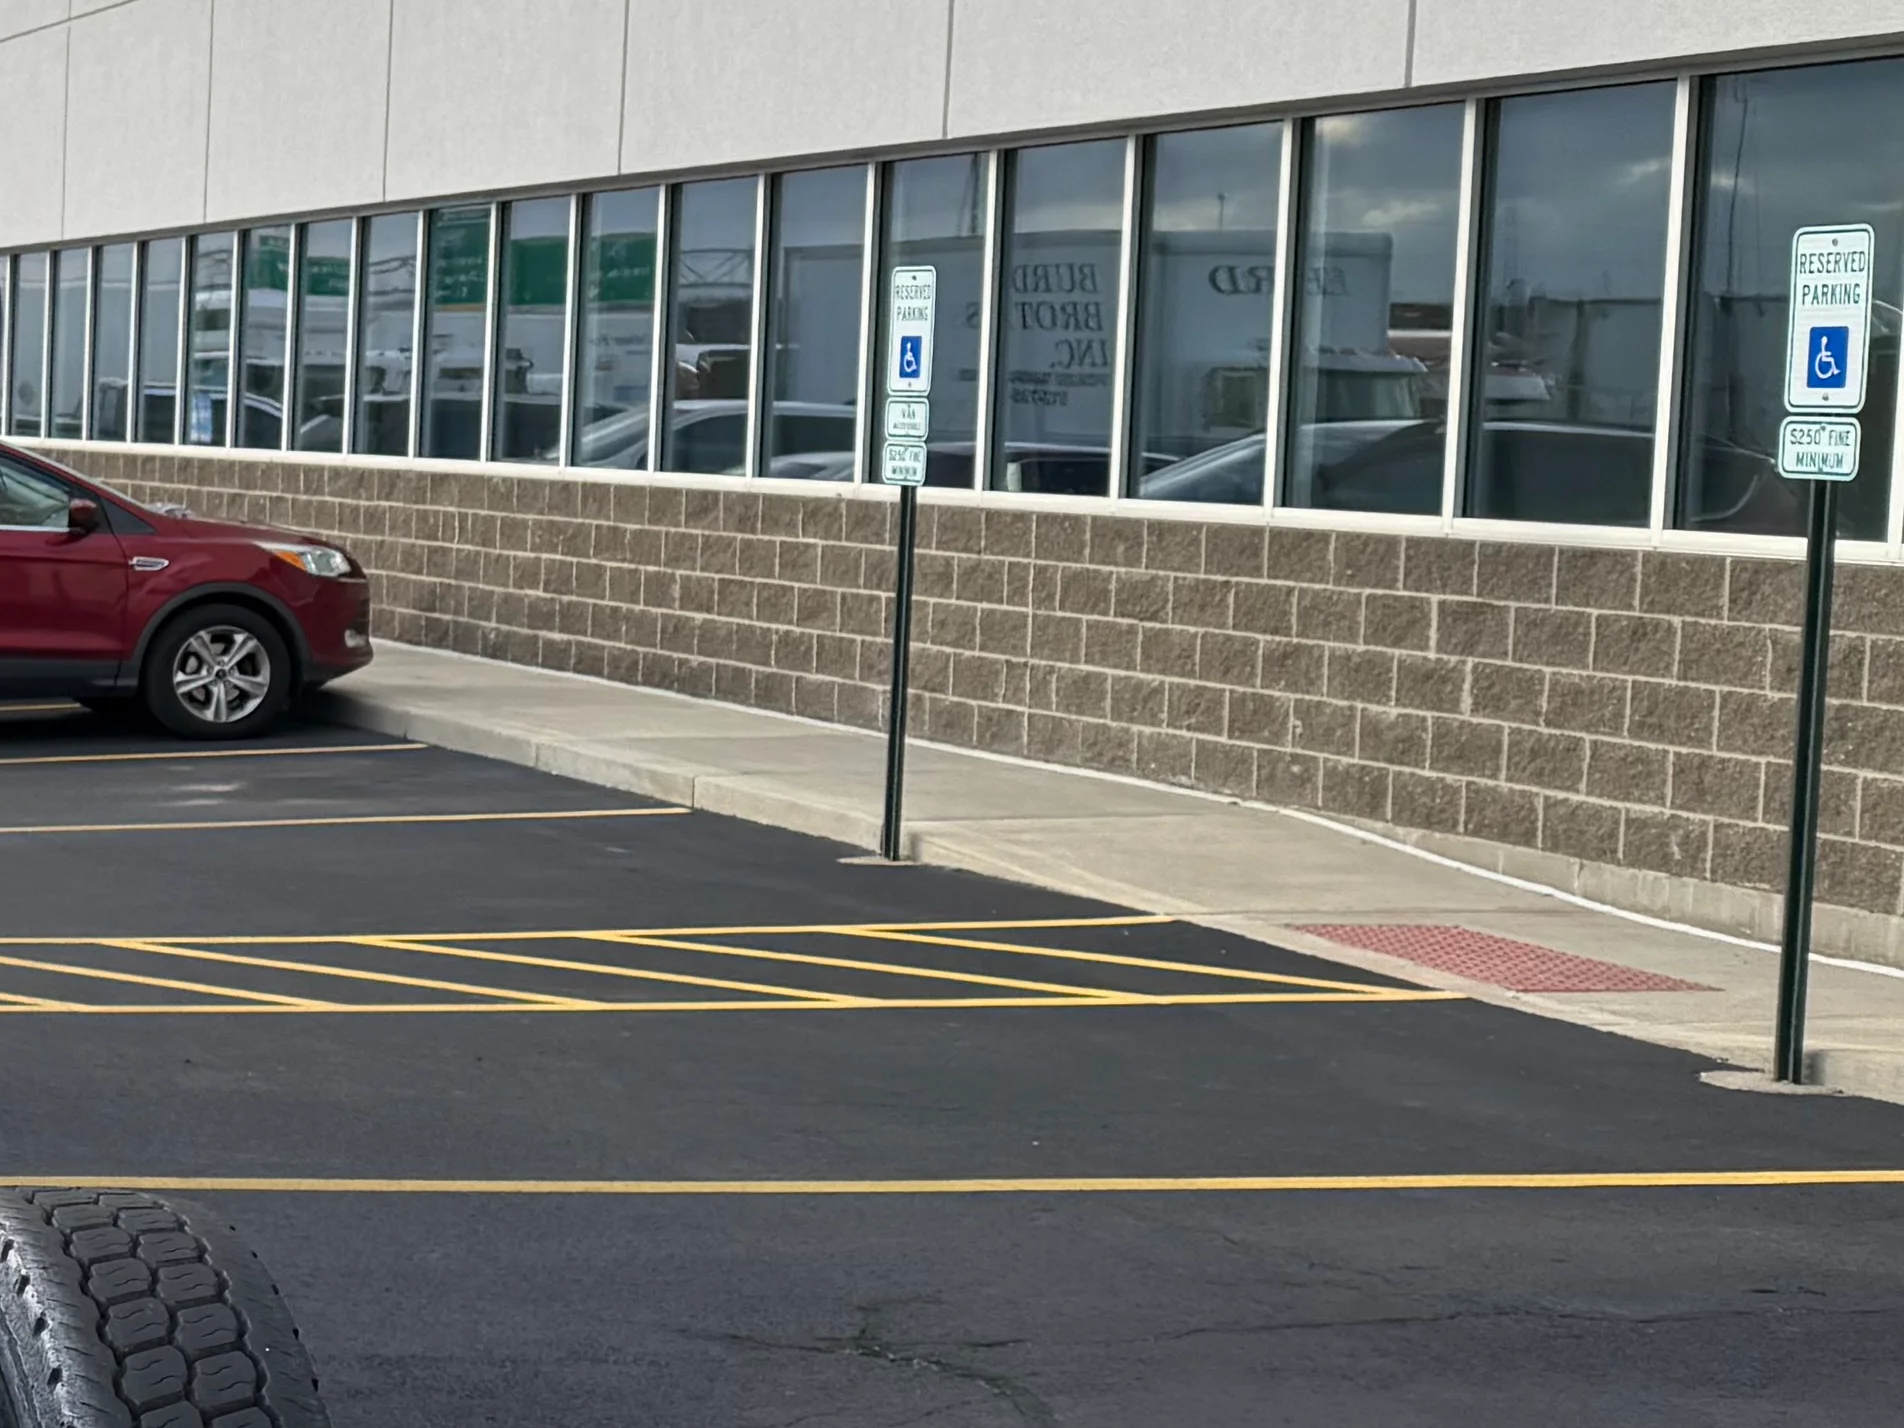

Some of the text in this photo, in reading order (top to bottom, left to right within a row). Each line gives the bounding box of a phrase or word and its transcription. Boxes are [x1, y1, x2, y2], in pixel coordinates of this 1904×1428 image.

[1798, 250, 1867, 274] RESERVED
[894, 284, 932, 300] RESERVED
[1801, 283, 1861, 307] PARKING
[896, 305, 929, 321] PARKING
[1828, 429, 1852, 446] FINE
[1795, 452, 1845, 470] MINIMUM
